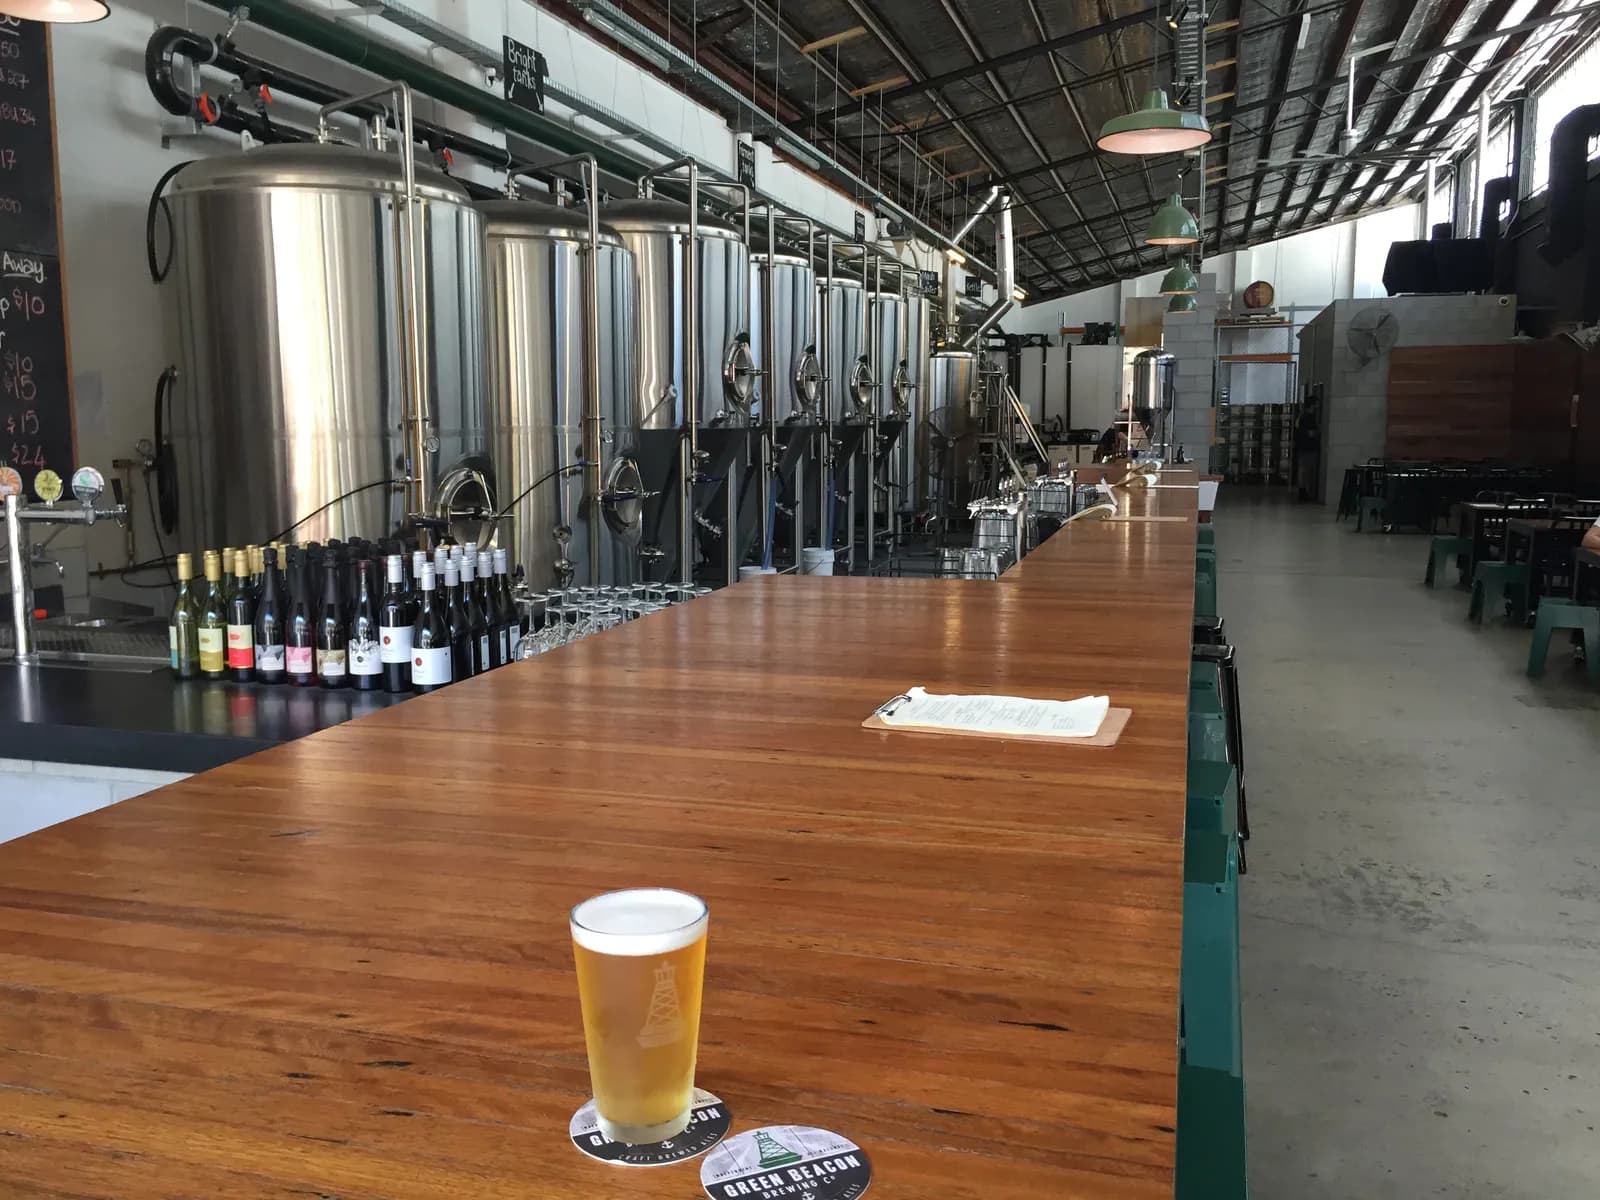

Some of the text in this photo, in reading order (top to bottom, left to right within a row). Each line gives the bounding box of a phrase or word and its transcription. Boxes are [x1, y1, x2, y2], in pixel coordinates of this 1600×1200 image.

[507, 38, 537, 72] Bright
[512, 66, 537, 90] tanks
[723, 1155, 861, 1197] GREEN BEACON
[763, 1180, 818, 1199] BREWING
